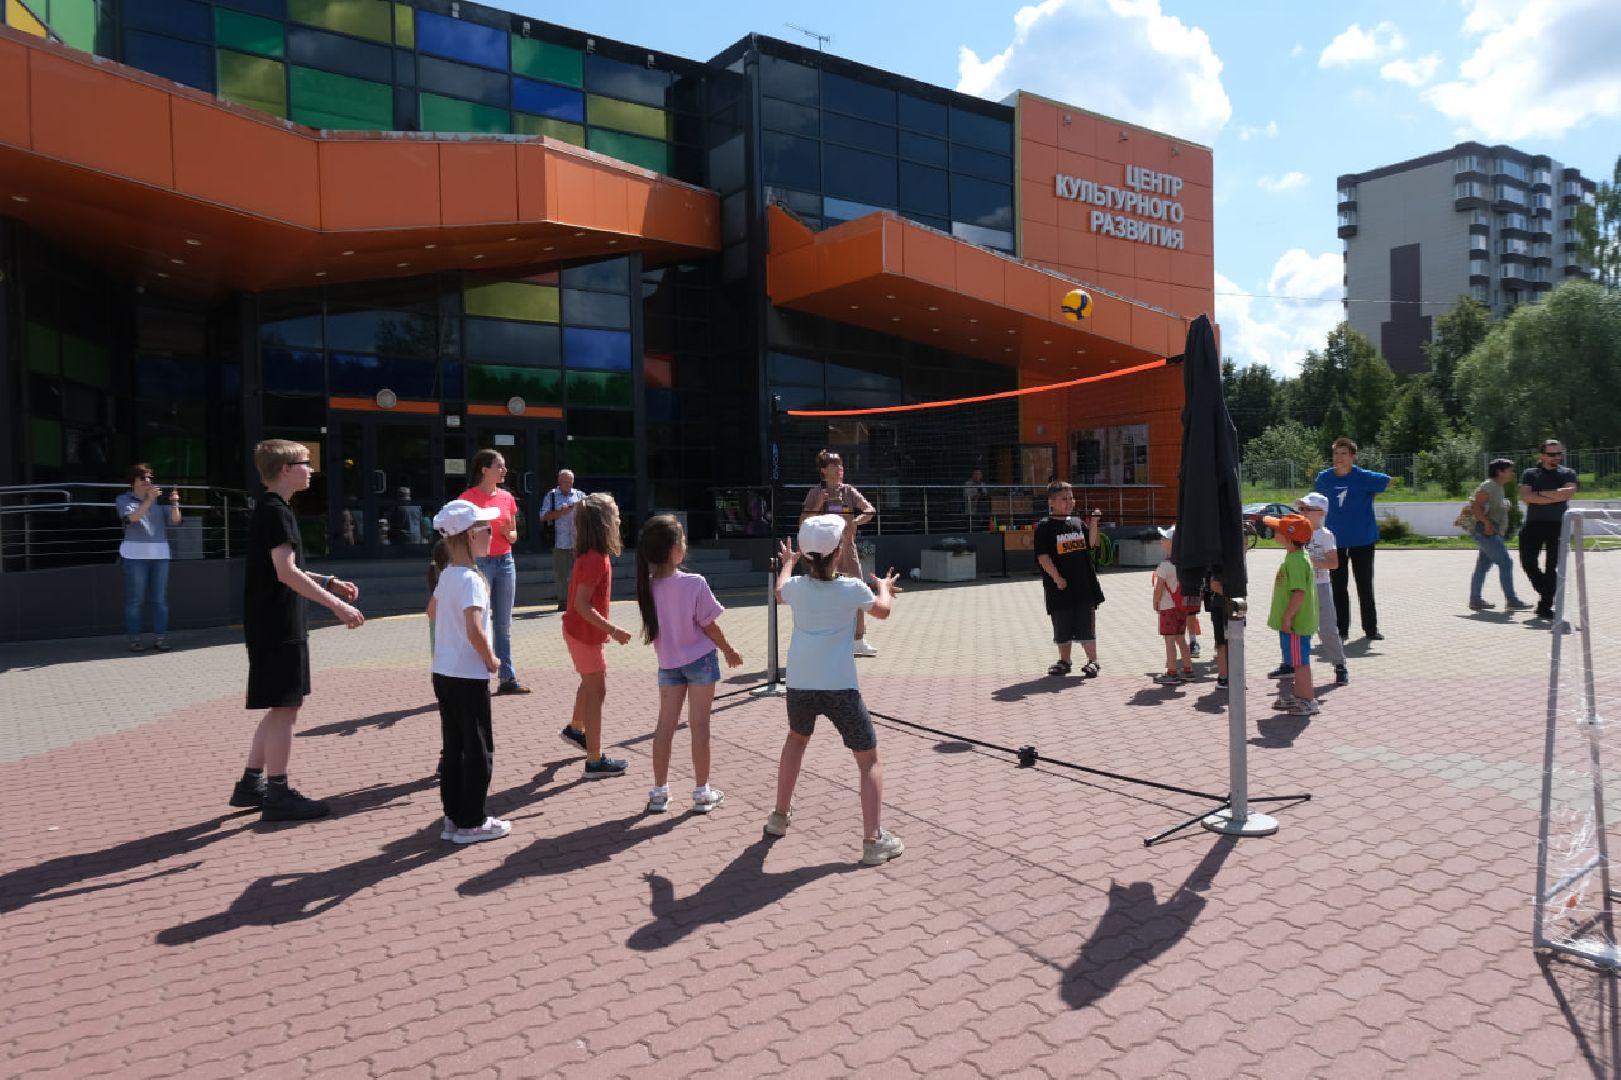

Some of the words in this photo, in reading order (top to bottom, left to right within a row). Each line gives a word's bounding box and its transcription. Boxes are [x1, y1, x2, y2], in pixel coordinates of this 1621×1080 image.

[1055, 173, 1184, 223] КУЛЬТУРНОГО
[1125, 164, 1183, 197] ЦЕНТР
[1090, 210, 1185, 250] РАЗВИТИЯ
